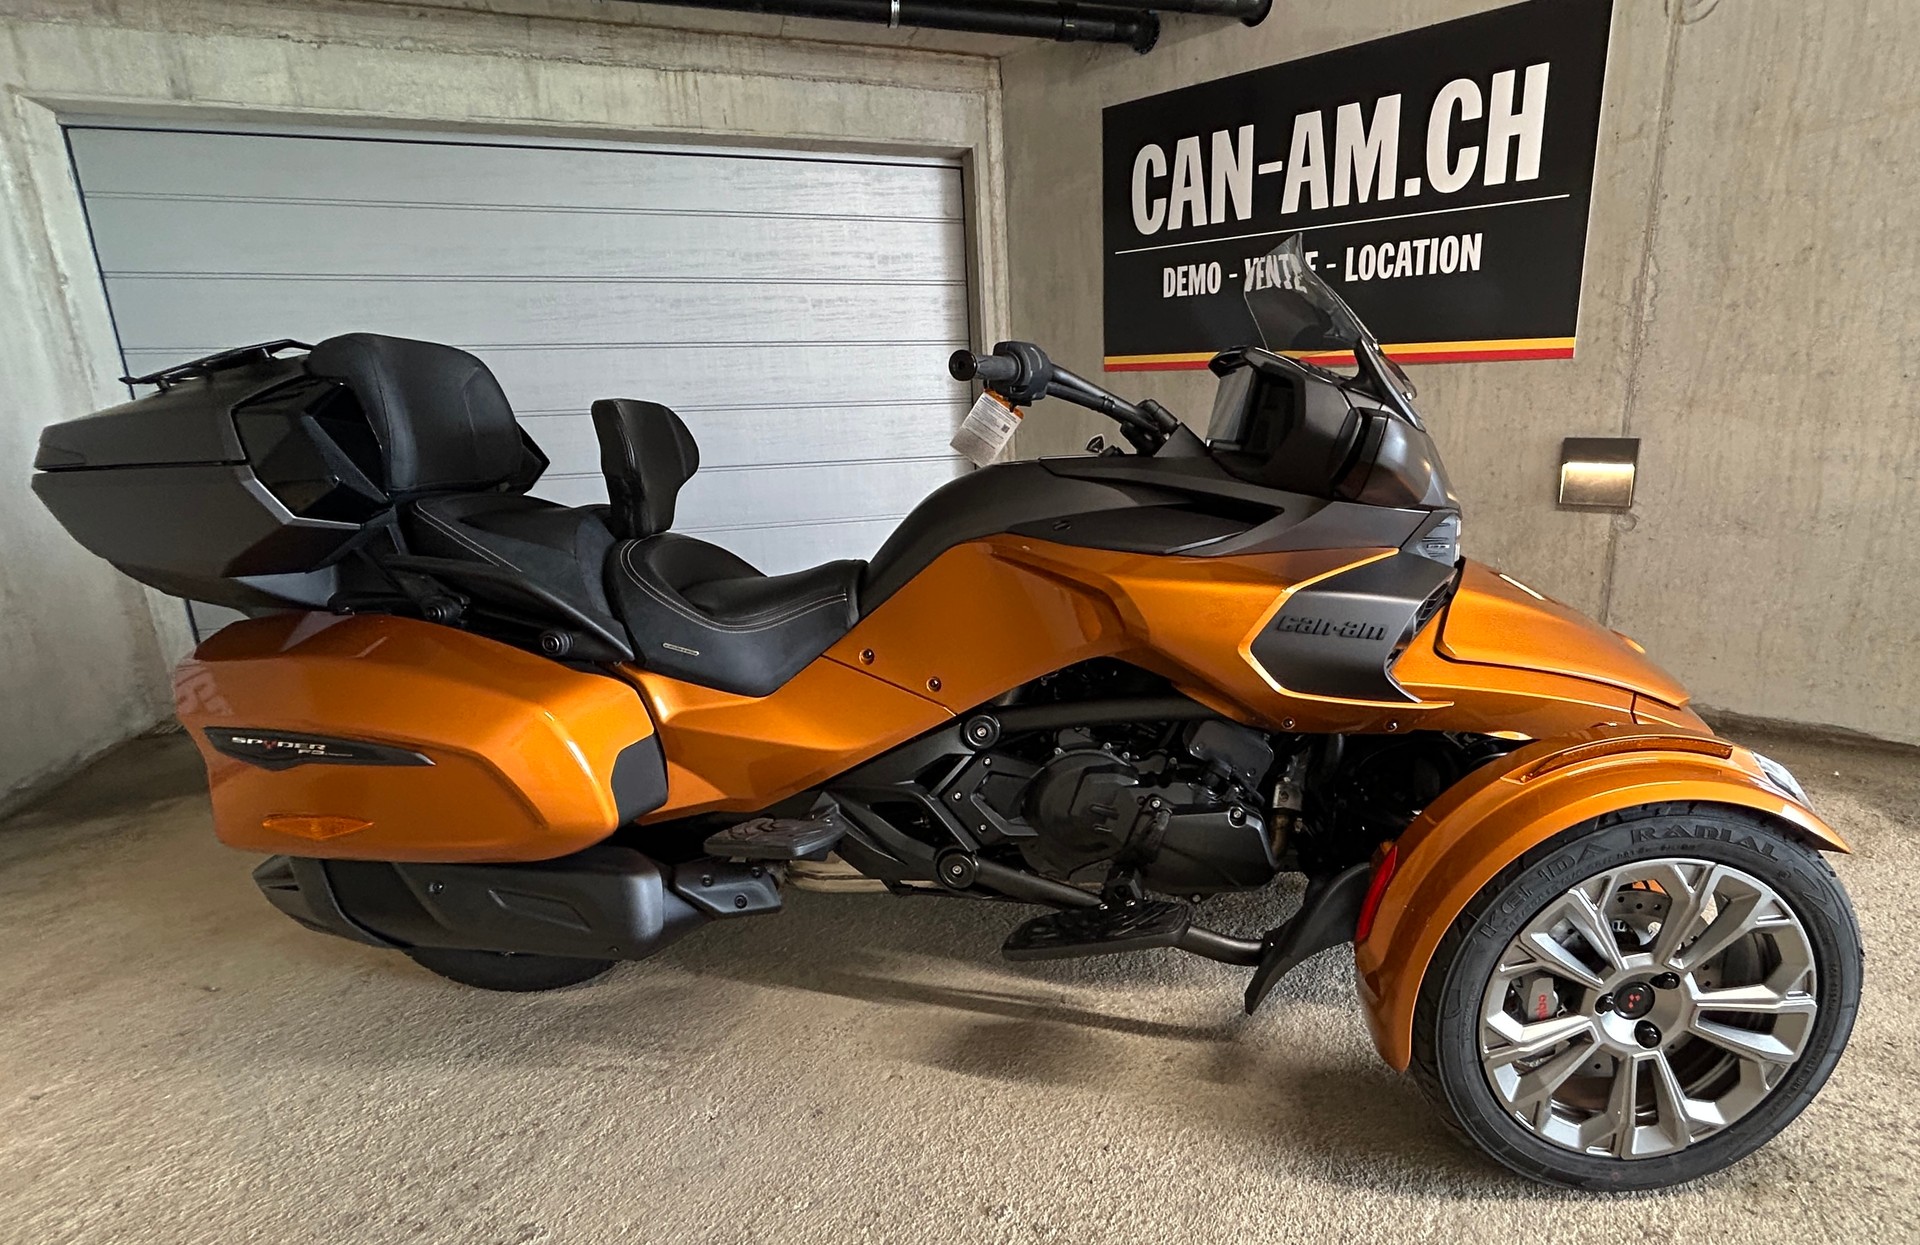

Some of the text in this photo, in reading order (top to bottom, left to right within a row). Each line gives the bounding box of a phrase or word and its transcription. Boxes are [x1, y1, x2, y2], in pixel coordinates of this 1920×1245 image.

[1131, 61, 1551, 236] CAN-AM.CH
[1163, 261, 1222, 298] DEMO
[1344, 232, 1483, 282] LOCATION
[231, 736, 326, 750] SPYDER
[1480, 843, 1613, 939] KENDA
[1630, 823, 1779, 862] RADIAL
